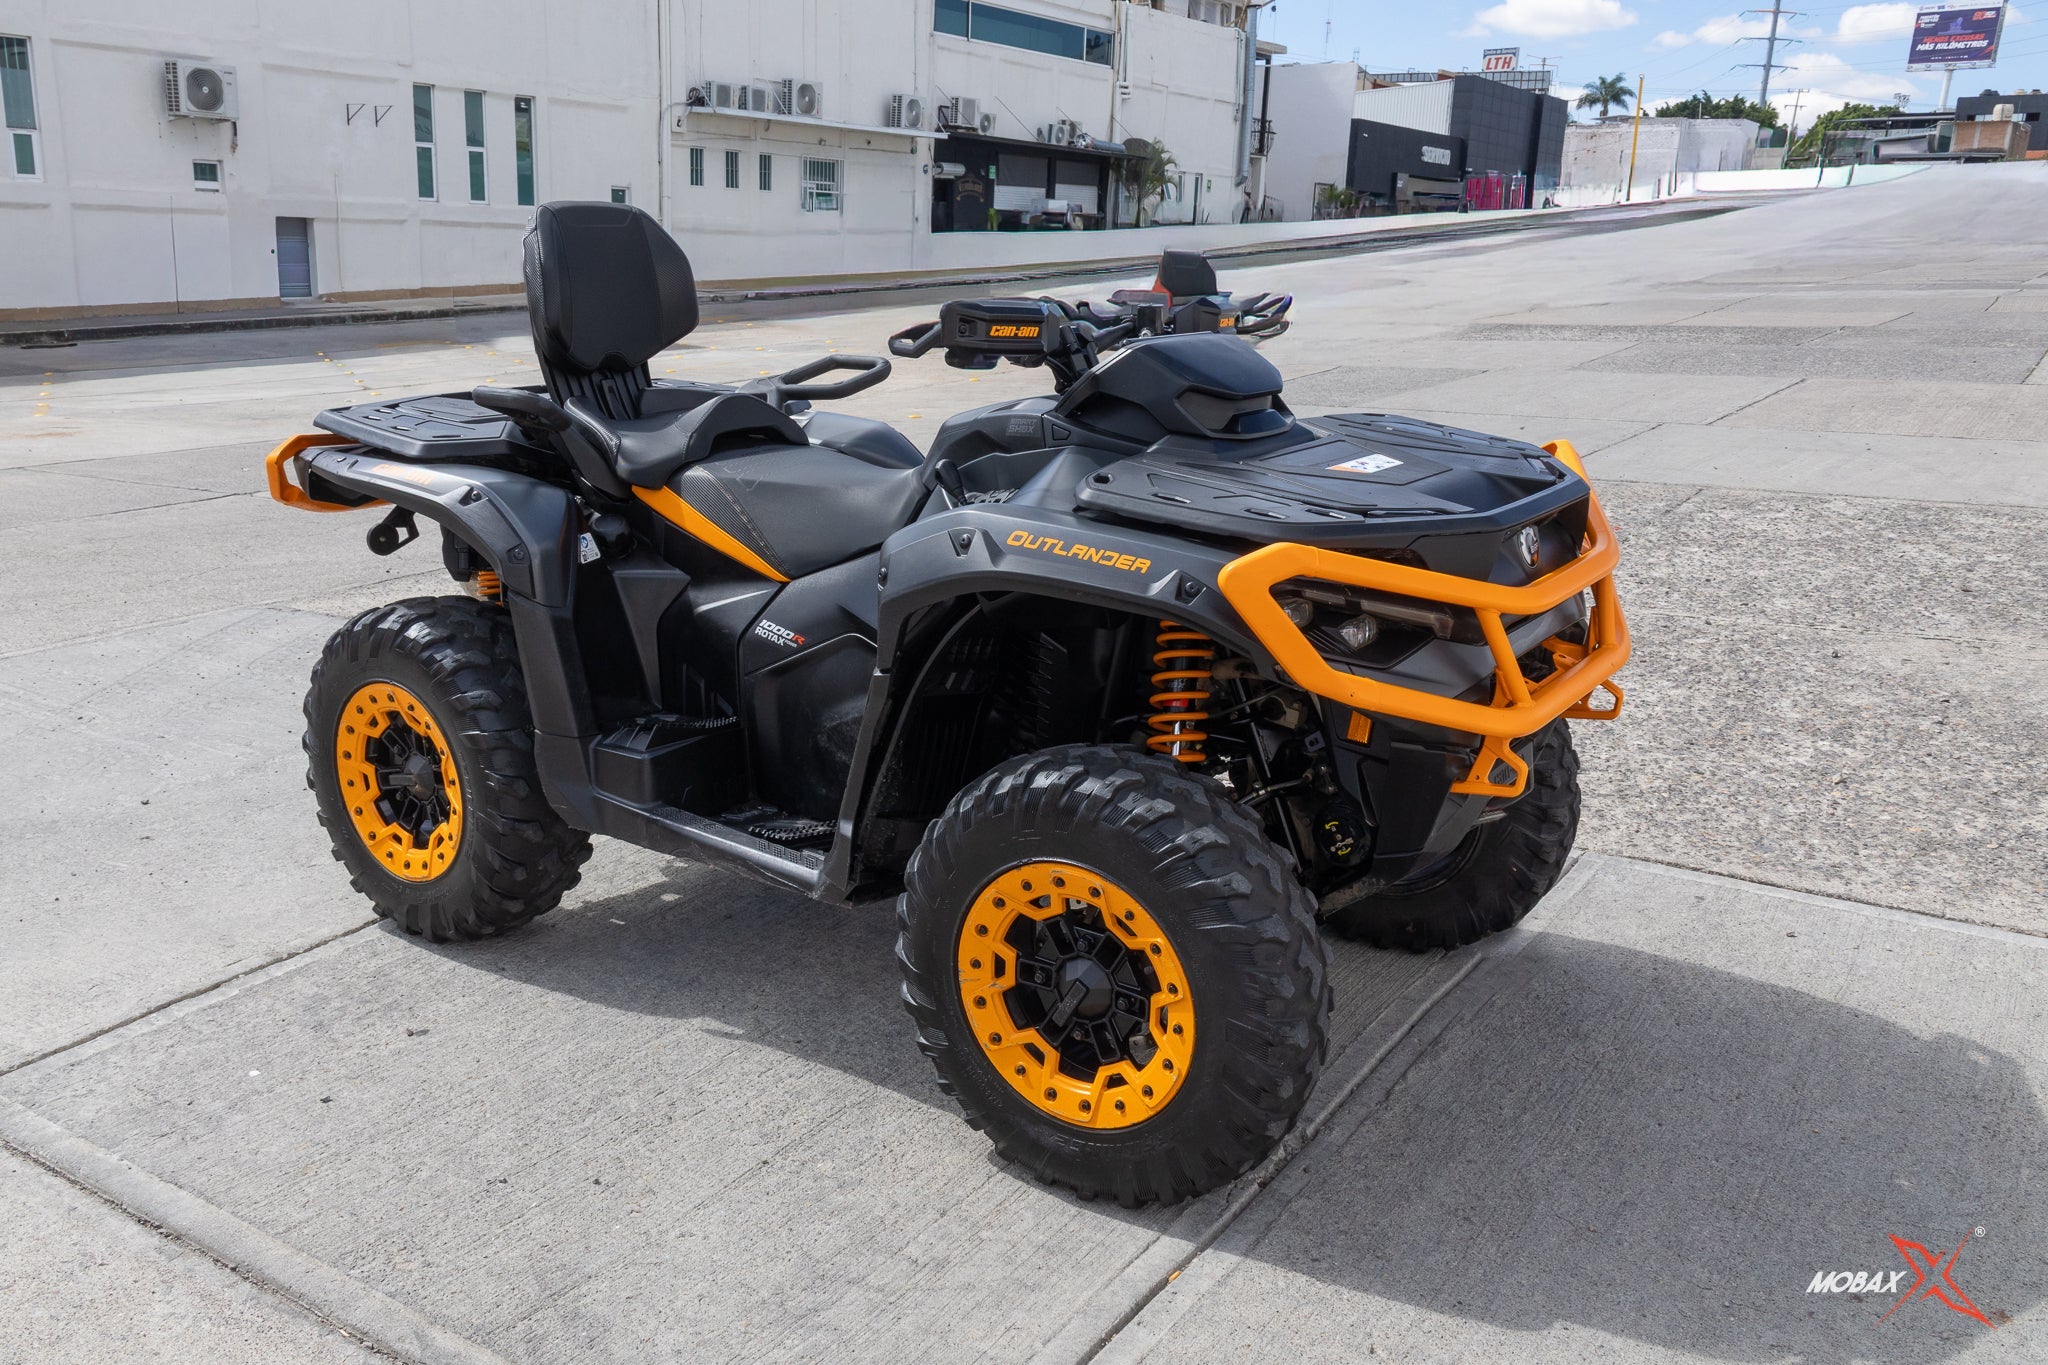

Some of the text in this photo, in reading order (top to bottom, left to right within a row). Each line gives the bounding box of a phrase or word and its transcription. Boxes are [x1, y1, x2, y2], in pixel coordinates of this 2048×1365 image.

[1916, 40, 1989, 51] MÁS KILÓMETROS
[1485, 56, 1513, 70] LTH
[990, 325, 1040, 337] can-am
[1006, 530, 1152, 574] OUTLANDER
[754, 626, 786, 647] ROTAX
[758, 619, 806, 645] 1000R
